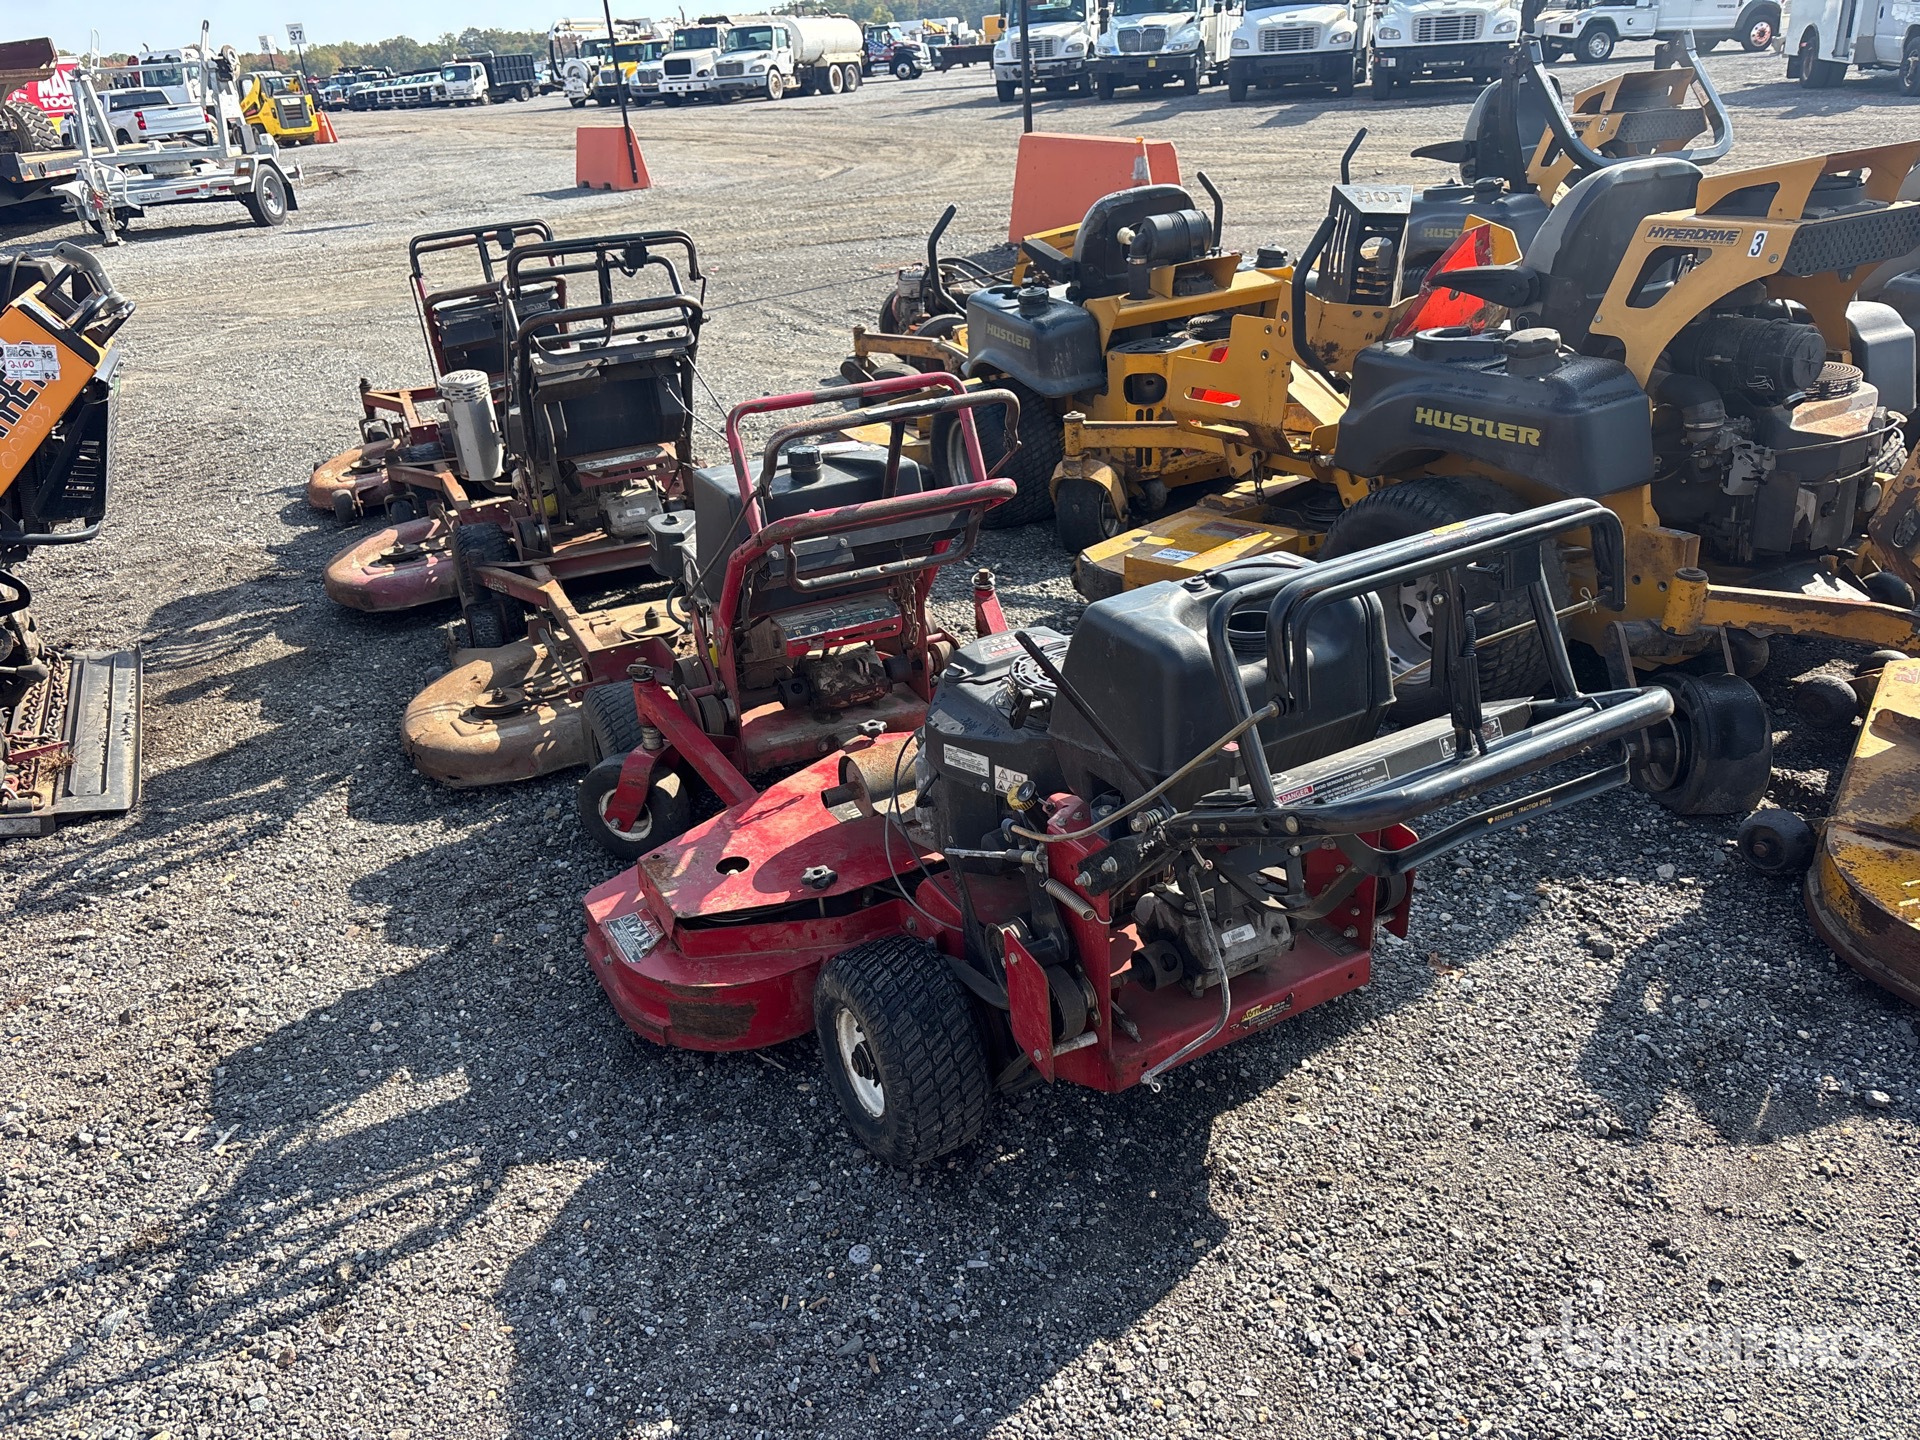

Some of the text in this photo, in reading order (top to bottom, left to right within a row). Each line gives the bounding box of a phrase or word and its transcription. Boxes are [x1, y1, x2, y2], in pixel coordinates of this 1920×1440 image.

[290, 30, 303, 41] 37
[1600, 118, 1608, 131] 6
[1355, 191, 1403, 203] HOT
[1647, 226, 1740, 240] HYPERDRIVE
[1750, 232, 1765, 256] 3
[986, 323, 1031, 350] HUSTLER
[1415, 406, 1541, 447] HUSTLER
[1281, 788, 1309, 802] DANGER
[1494, 811, 1514, 821] REVERSE
[1518, 802, 1538, 813] TRACTION
[1538, 797, 1552, 806] DRIVE
